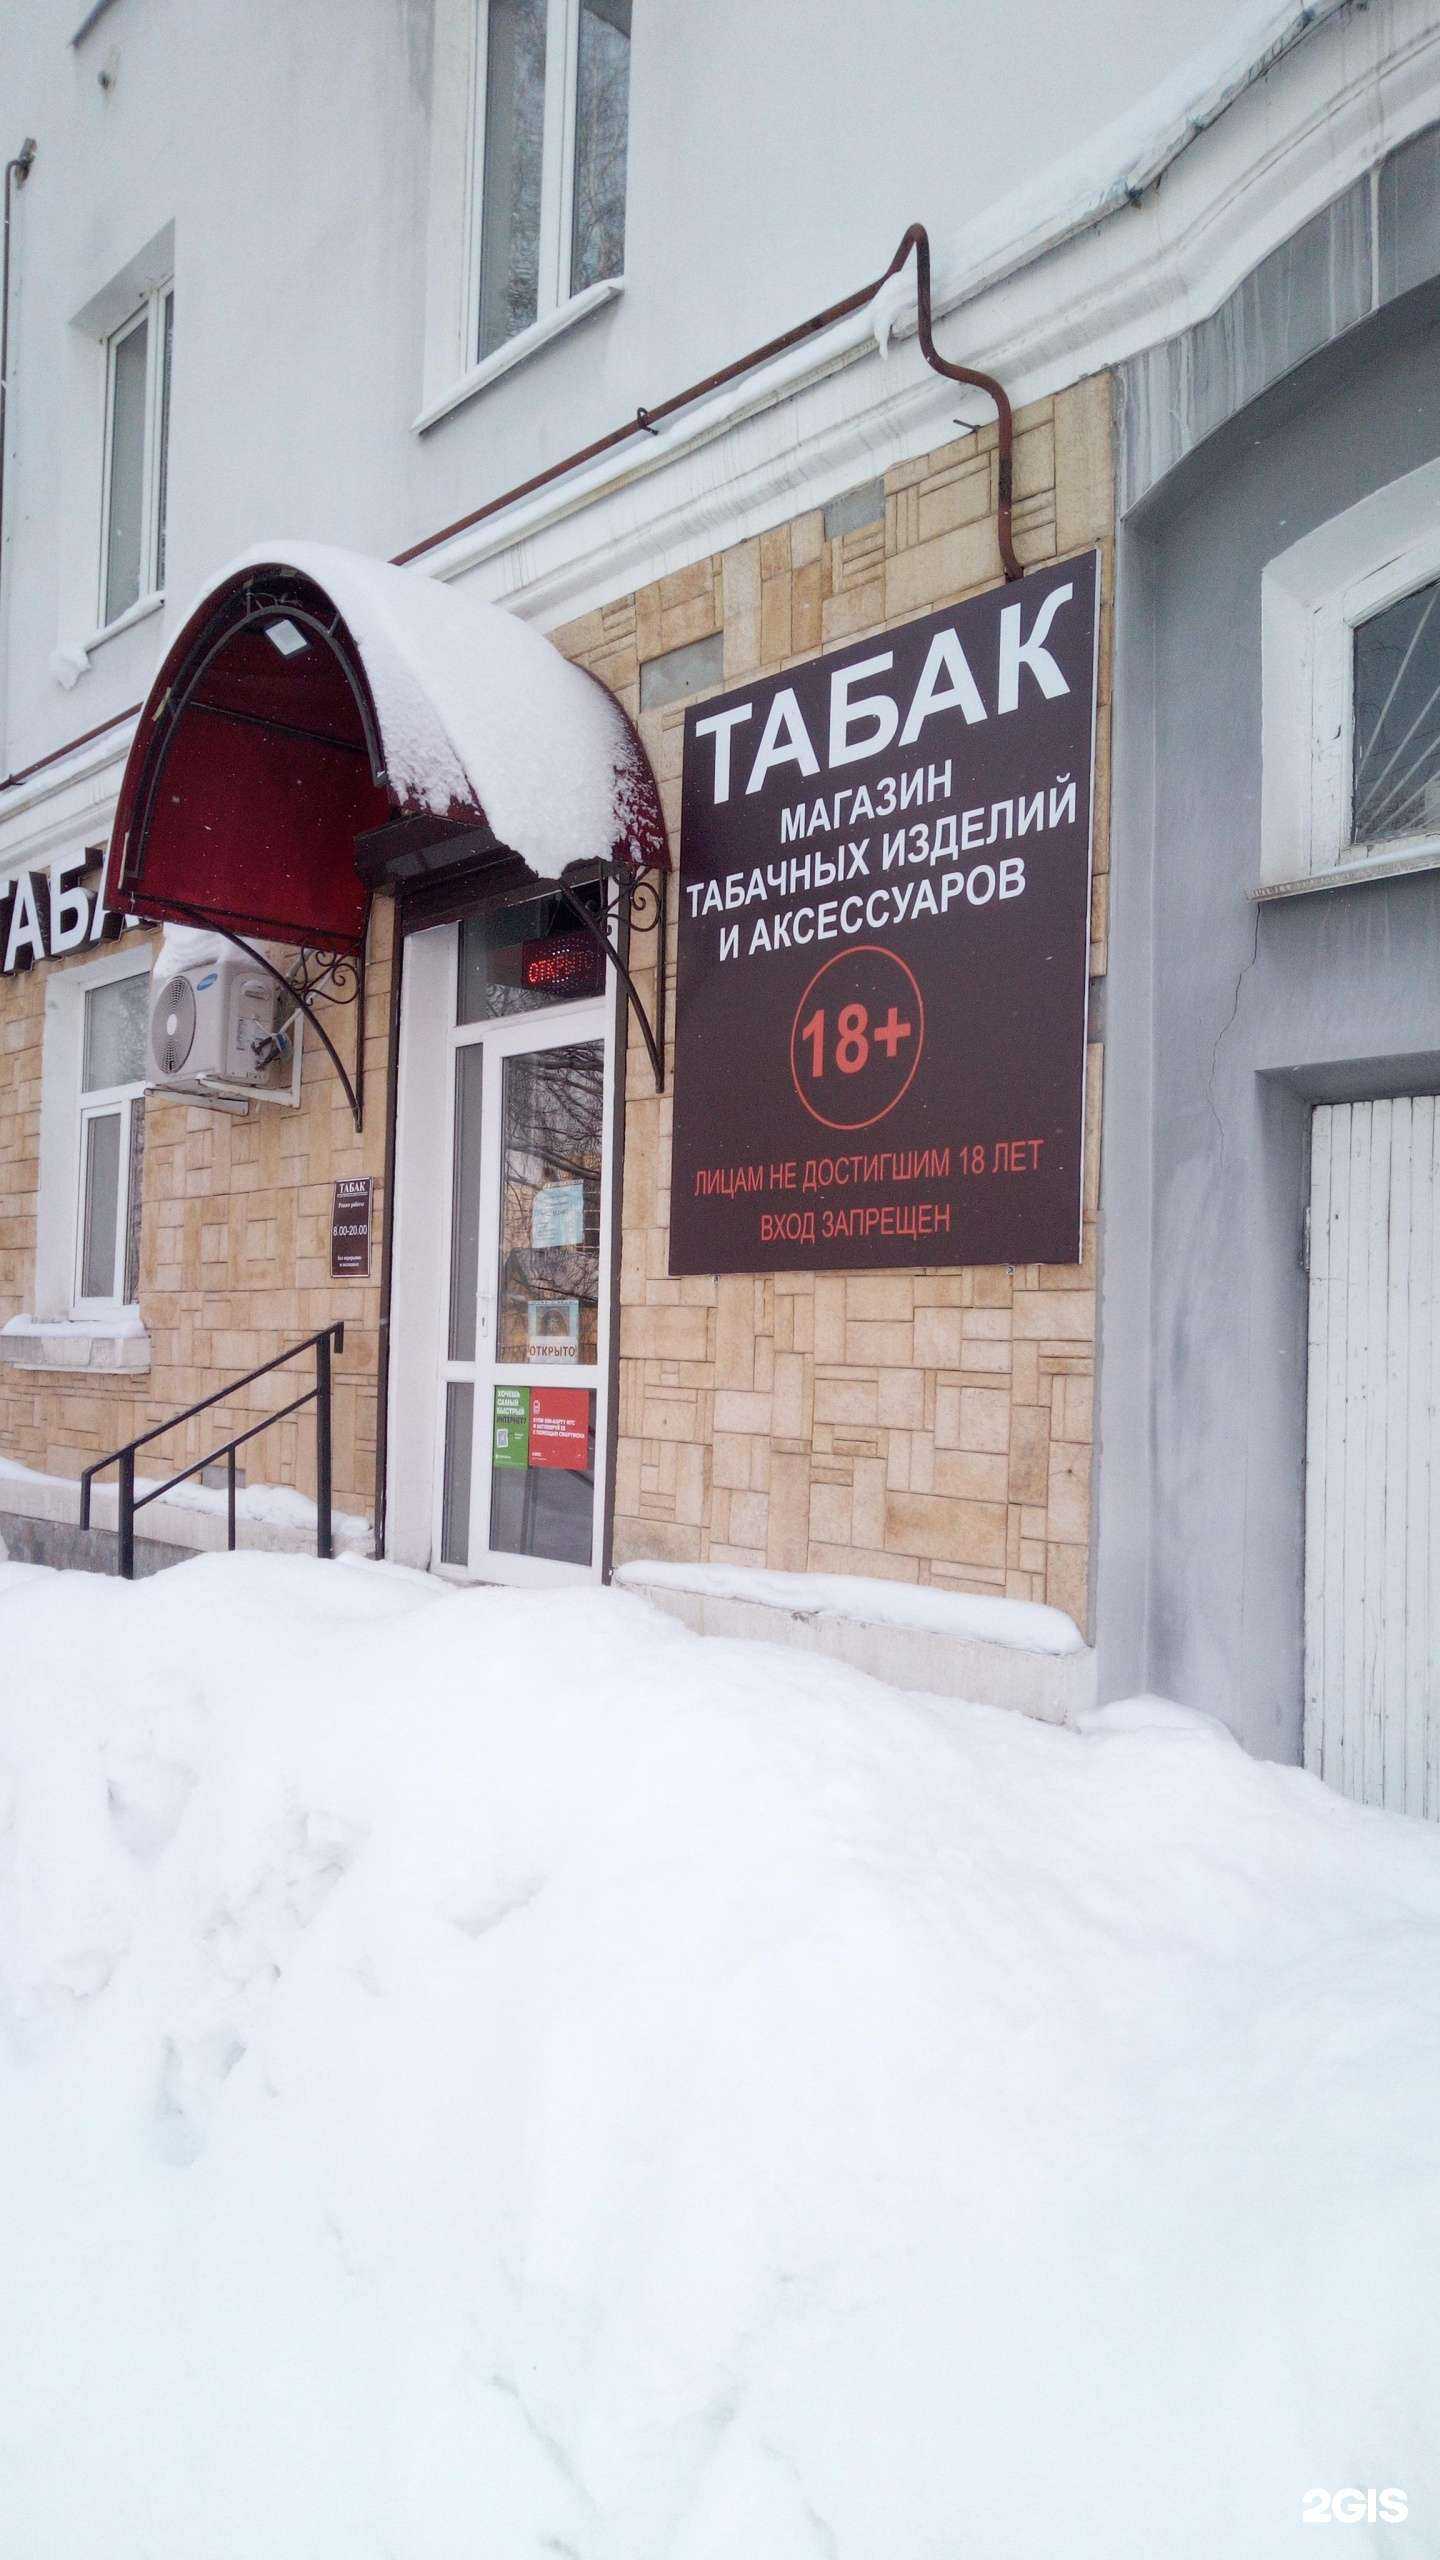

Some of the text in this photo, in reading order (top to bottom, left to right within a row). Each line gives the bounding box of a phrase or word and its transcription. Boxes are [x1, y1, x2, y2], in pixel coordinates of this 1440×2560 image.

[696, 582, 1073, 804] ТАБАК
[780, 759, 952, 843] МАГАЗИН
[687, 773, 1076, 917] ТАБАЧНЫХ ИЗДЕЛИЙ
[719, 857, 1026, 961] И АКСЕССУАРОВ
[802, 1003, 911, 1078] 18+
[340, 1182, 366, 1193] ТАБАК
[694, 1139, 1044, 1199] ЛИЦАМ НЕ ДОСТИГШИМ 18 ЛЕТ
[761, 1205, 950, 1244] ВХОД ЗАПРЕЩЕН
[529, 1346, 576, 1357] ОТКРЫТО
